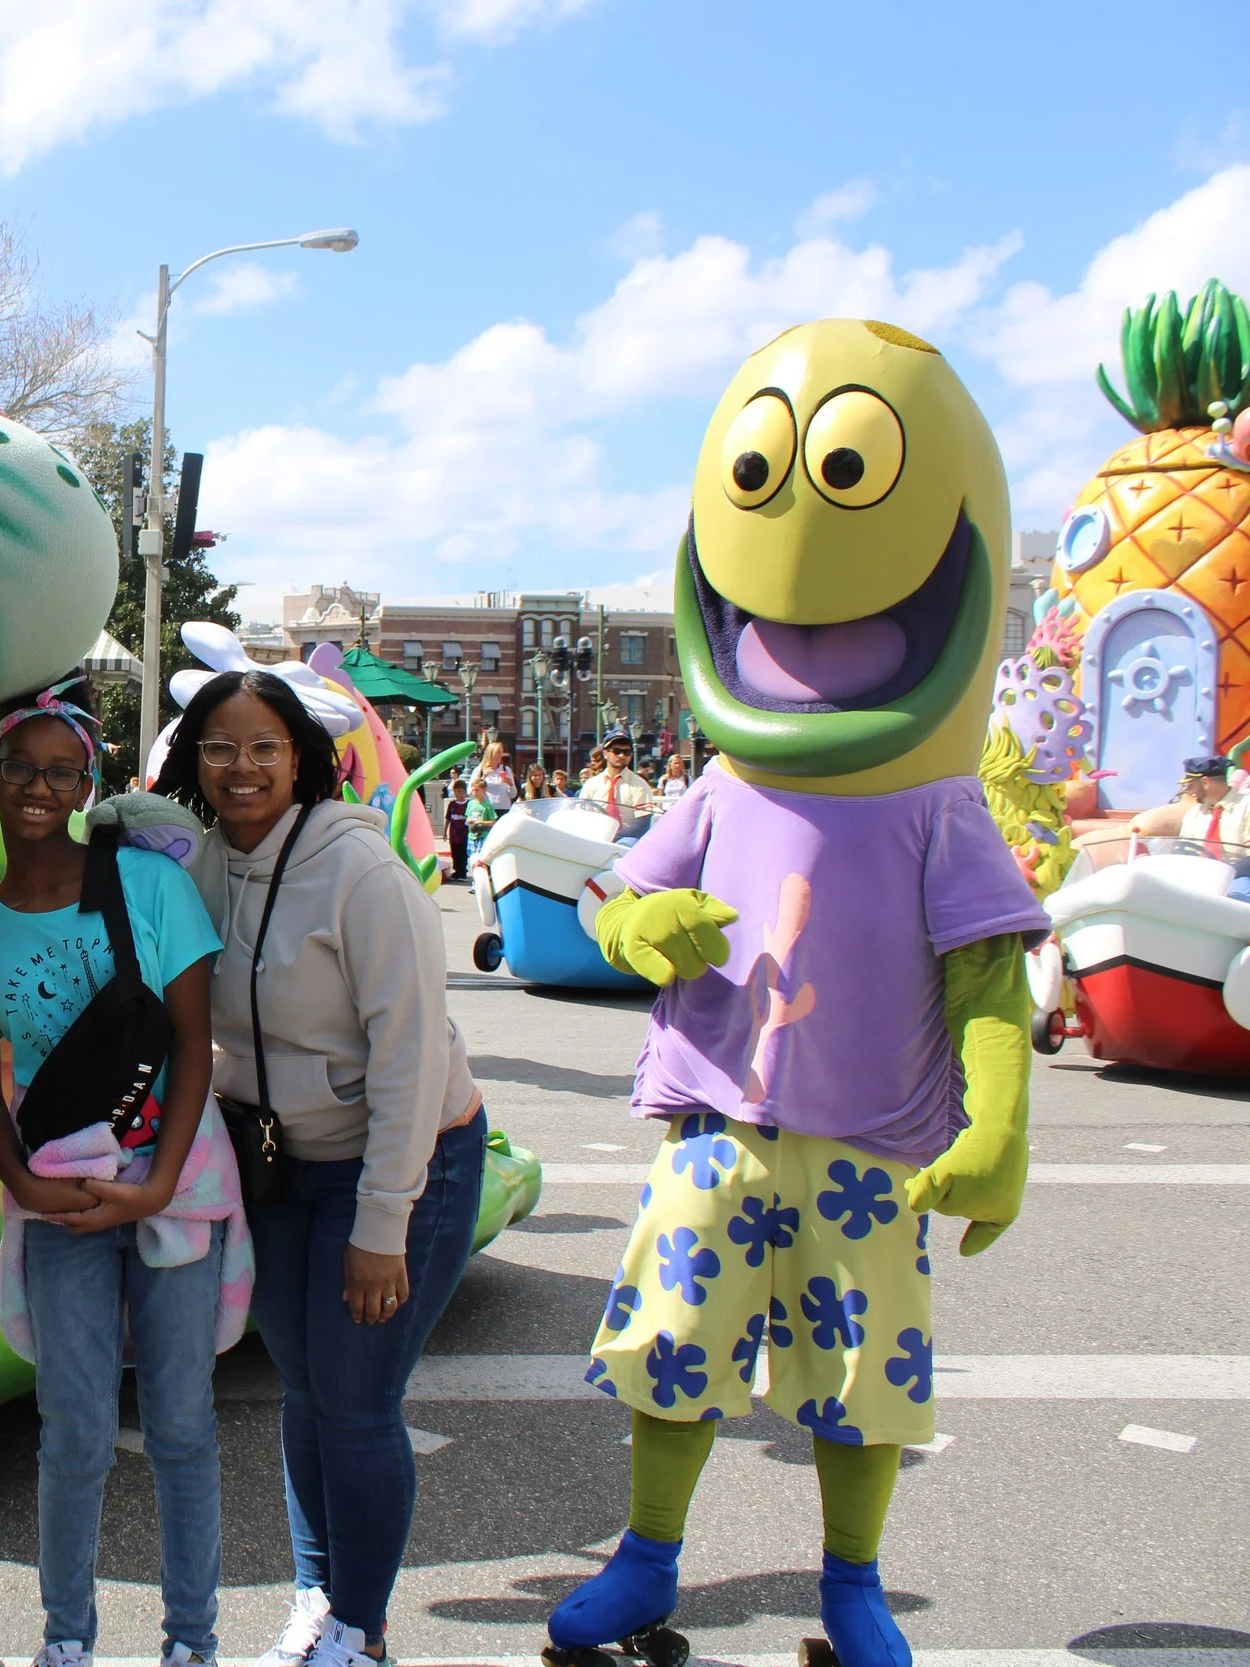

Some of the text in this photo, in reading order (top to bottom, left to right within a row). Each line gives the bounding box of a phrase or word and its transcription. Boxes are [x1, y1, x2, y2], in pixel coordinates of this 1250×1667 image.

[5, 938, 115, 1016] TAKE ME TO PA
[108, 1063, 153, 1129] ORDAN
